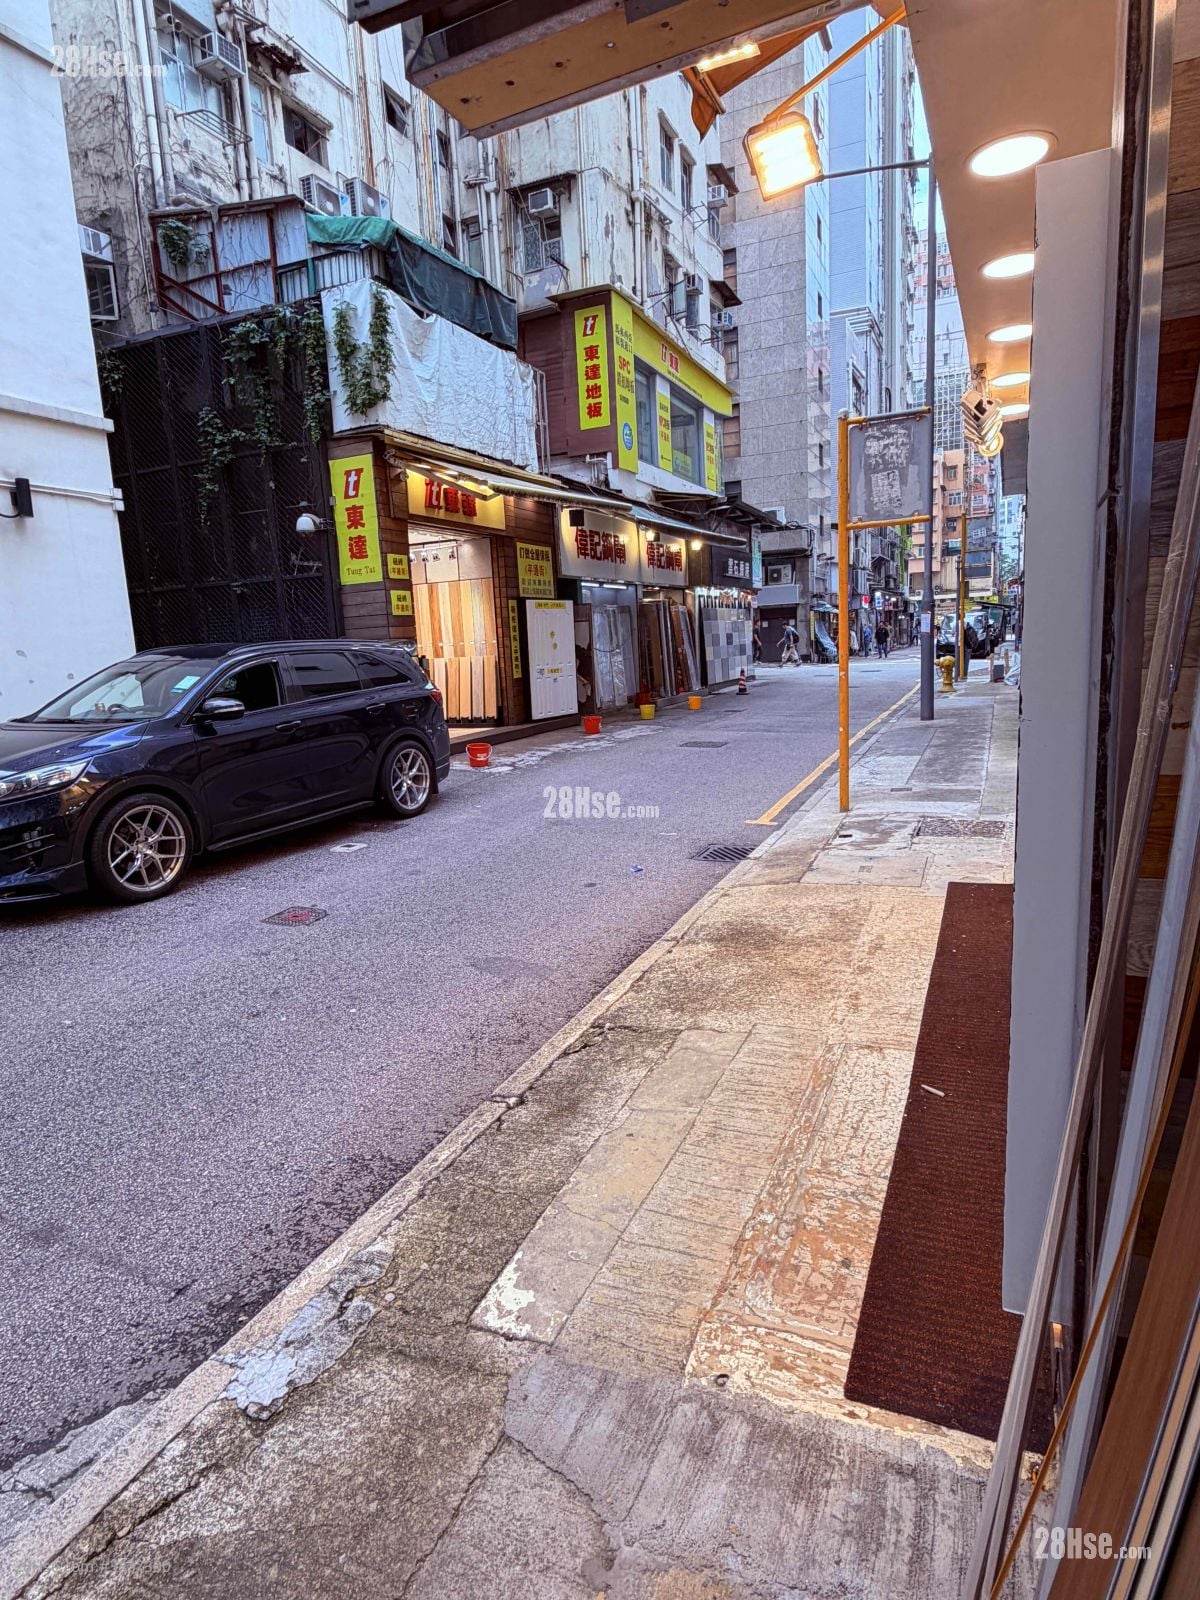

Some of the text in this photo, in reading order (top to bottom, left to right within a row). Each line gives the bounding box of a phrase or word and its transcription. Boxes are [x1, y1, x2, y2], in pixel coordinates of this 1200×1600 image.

[584, 345, 602, 419] 東達地板
[618, 354, 631, 375] SPC
[345, 504, 369, 560] 東達
[346, 567, 363, 577] Tung
